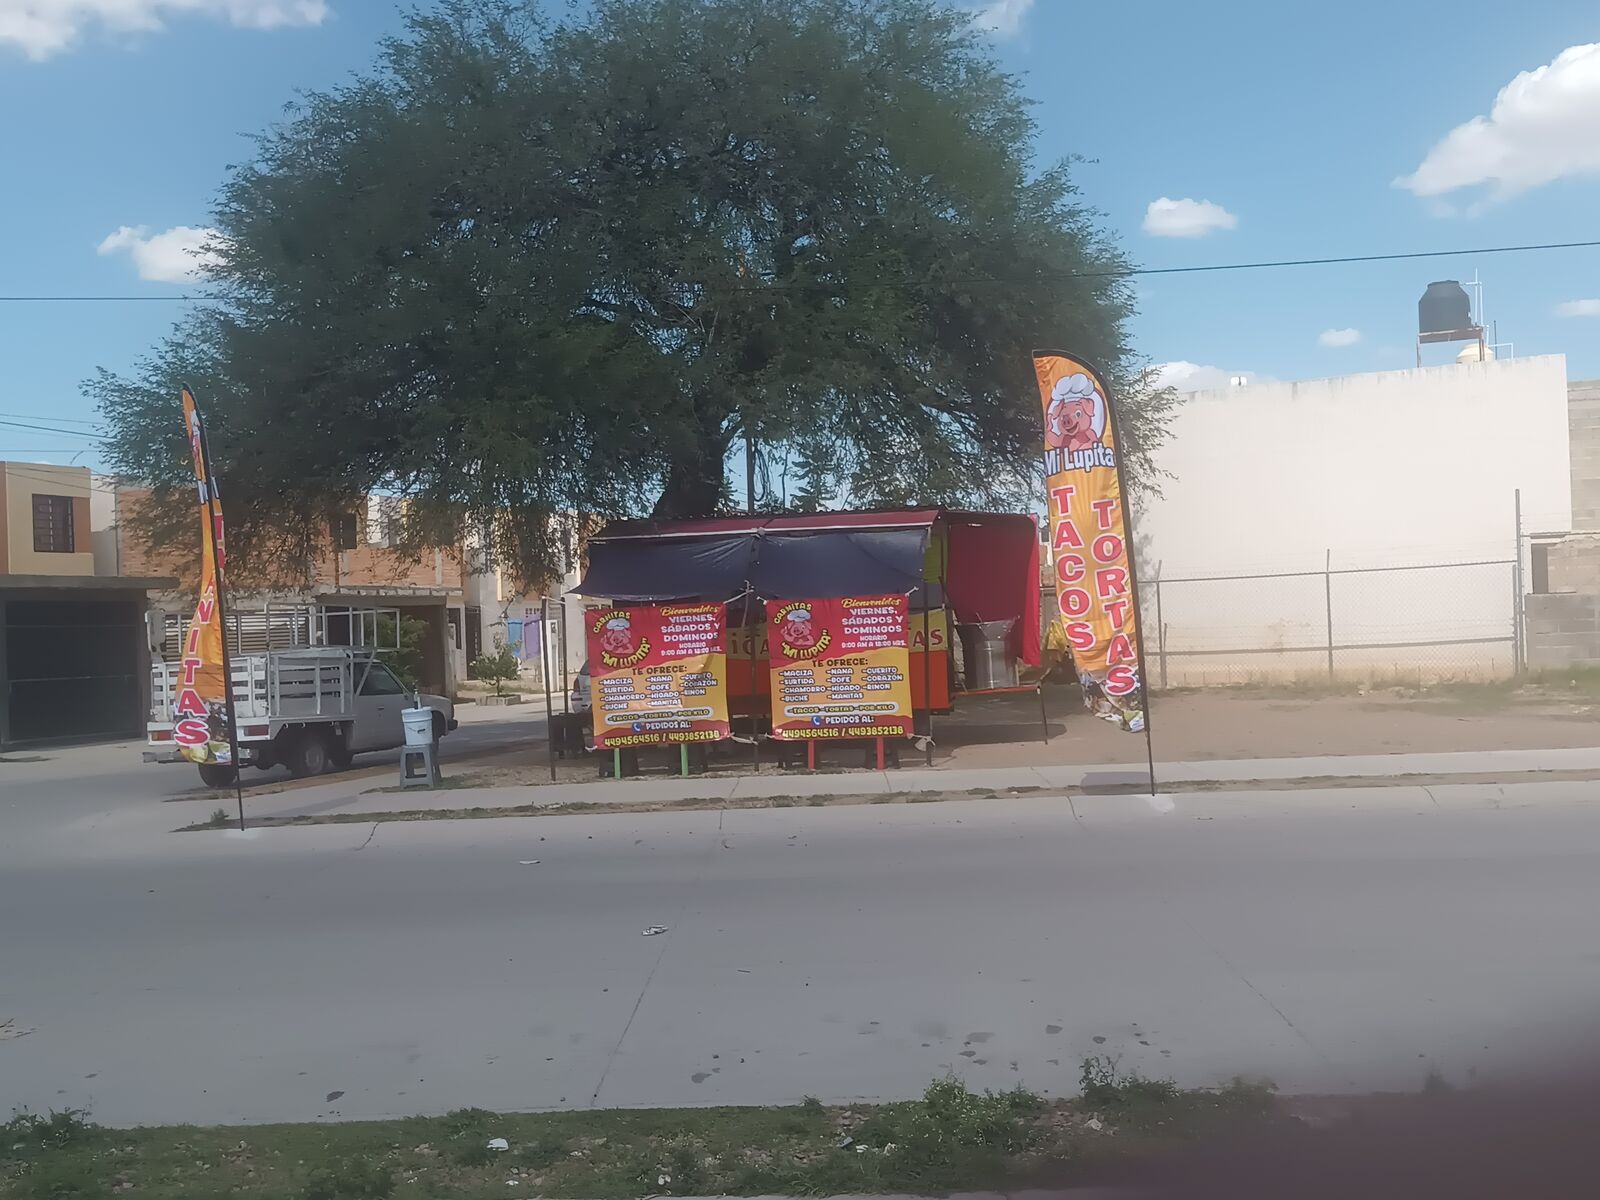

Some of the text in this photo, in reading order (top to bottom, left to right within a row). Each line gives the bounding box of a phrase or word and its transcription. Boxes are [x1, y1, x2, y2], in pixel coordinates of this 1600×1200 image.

[1064, 441, 1116, 473] Lupita
[1051, 485, 1096, 650] TACOS
[841, 598, 902, 608] Bienvenidos
[1091, 500, 1137, 695] TORTAS
[774, 602, 812, 624] CARNITAS
[850, 606, 897, 615] VIERNES,
[593, 611, 632, 633] CARNITAS
[713, 622, 721, 630] Y
[844, 625, 902, 634] DOMINGOS
[663, 632, 719, 642] DOMINGOS
[812, 657, 868, 668] TE OFRECE:
[632, 665, 688, 676] TE OFRECE:
[645, 721, 679, 730] PEDIDOS
[825, 716, 860, 725] PEDIDOS
[782, 728, 839, 738] 4494564516
[848, 726, 904, 736] 4493852138
[604, 733, 660, 747] 4494564516
